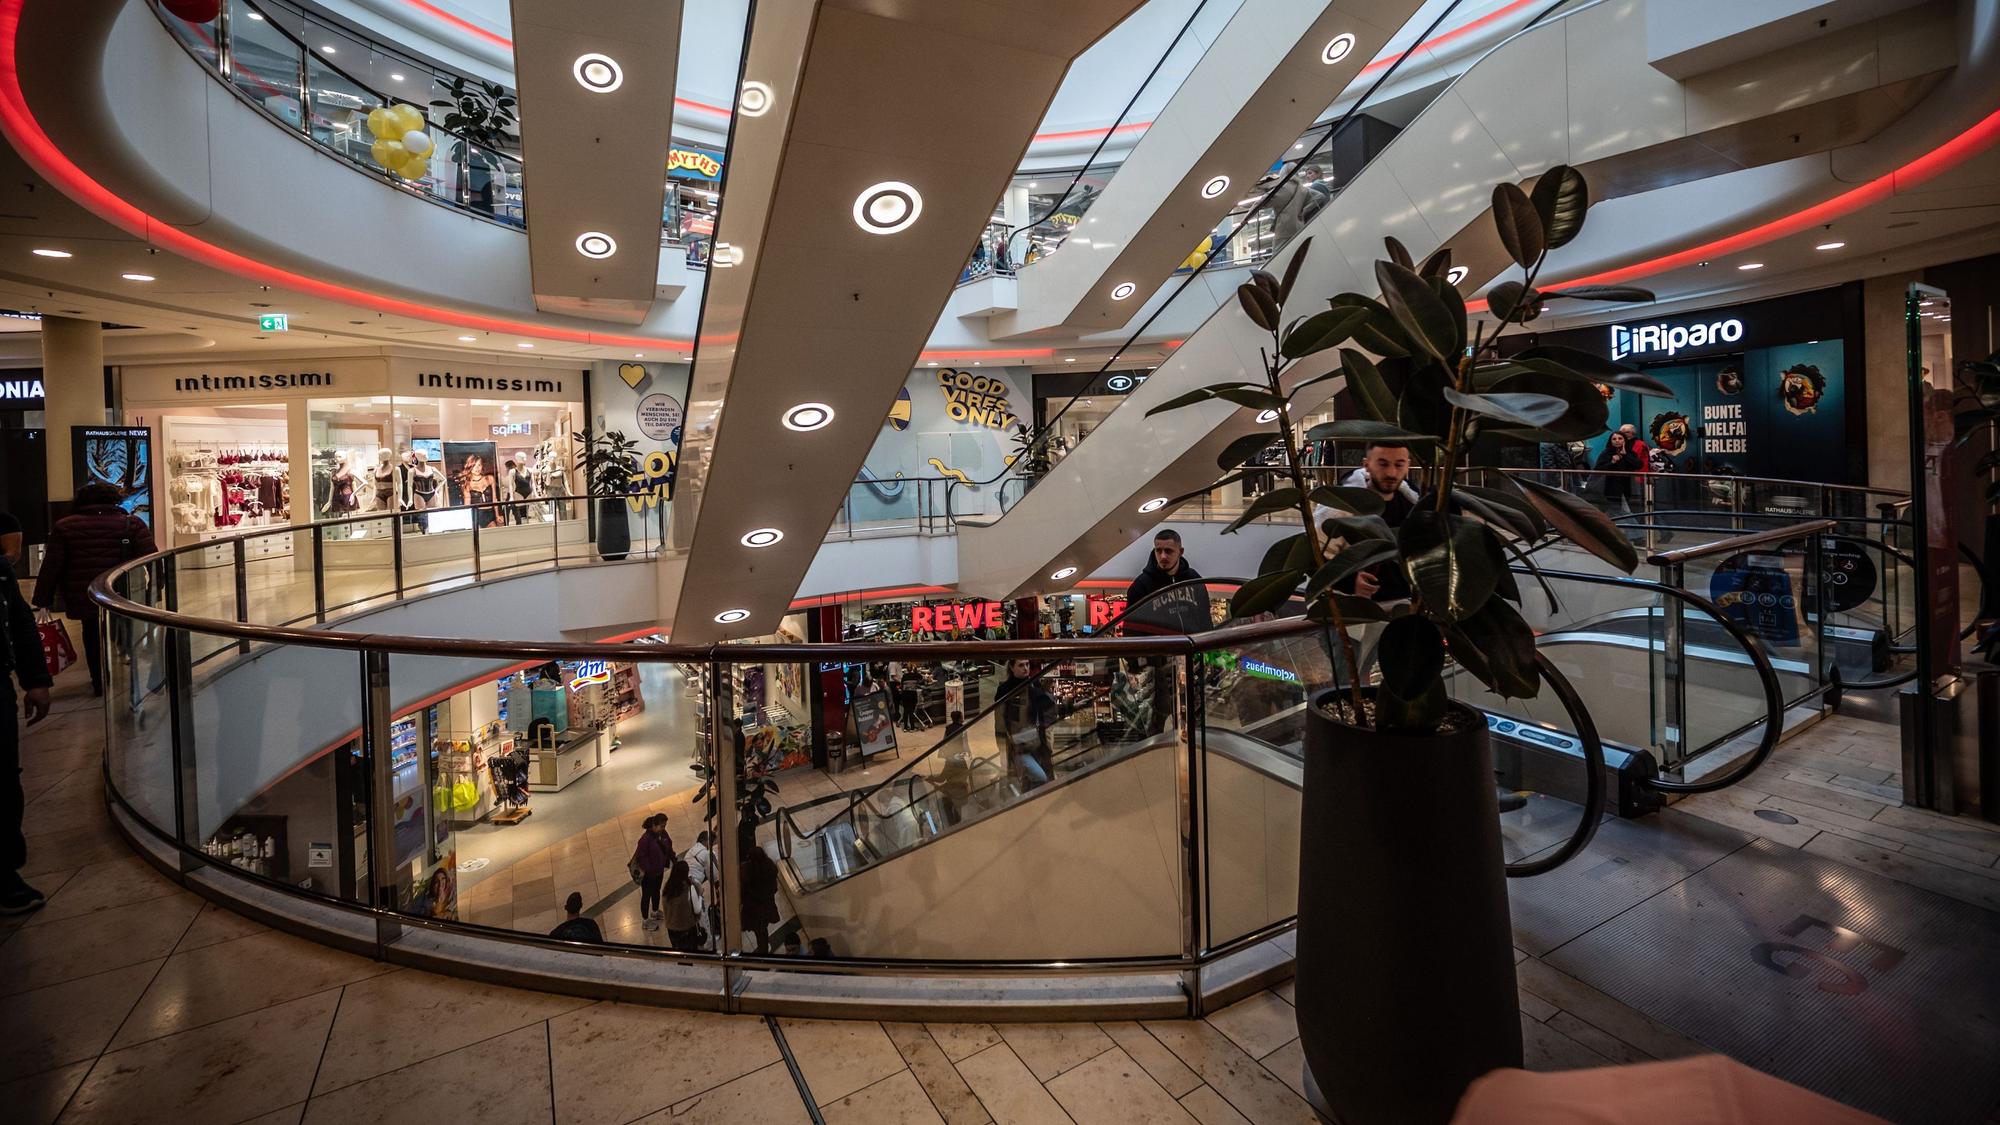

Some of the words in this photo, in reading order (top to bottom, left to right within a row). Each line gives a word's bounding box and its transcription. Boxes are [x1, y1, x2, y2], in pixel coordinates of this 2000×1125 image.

[1631, 318, 1744, 356] iRiparo
[175, 372, 332, 391] intimissimi
[419, 372, 562, 393] intimissimi
[936, 368, 1007, 396] GOOD
[940, 385, 1010, 413] VIBES
[945, 402, 1017, 430] ONLY
[1704, 404, 1742, 419] BUNTE
[128, 429, 148, 437] NEWS
[911, 602, 1003, 633] REWE
[578, 659, 604, 678] dm
